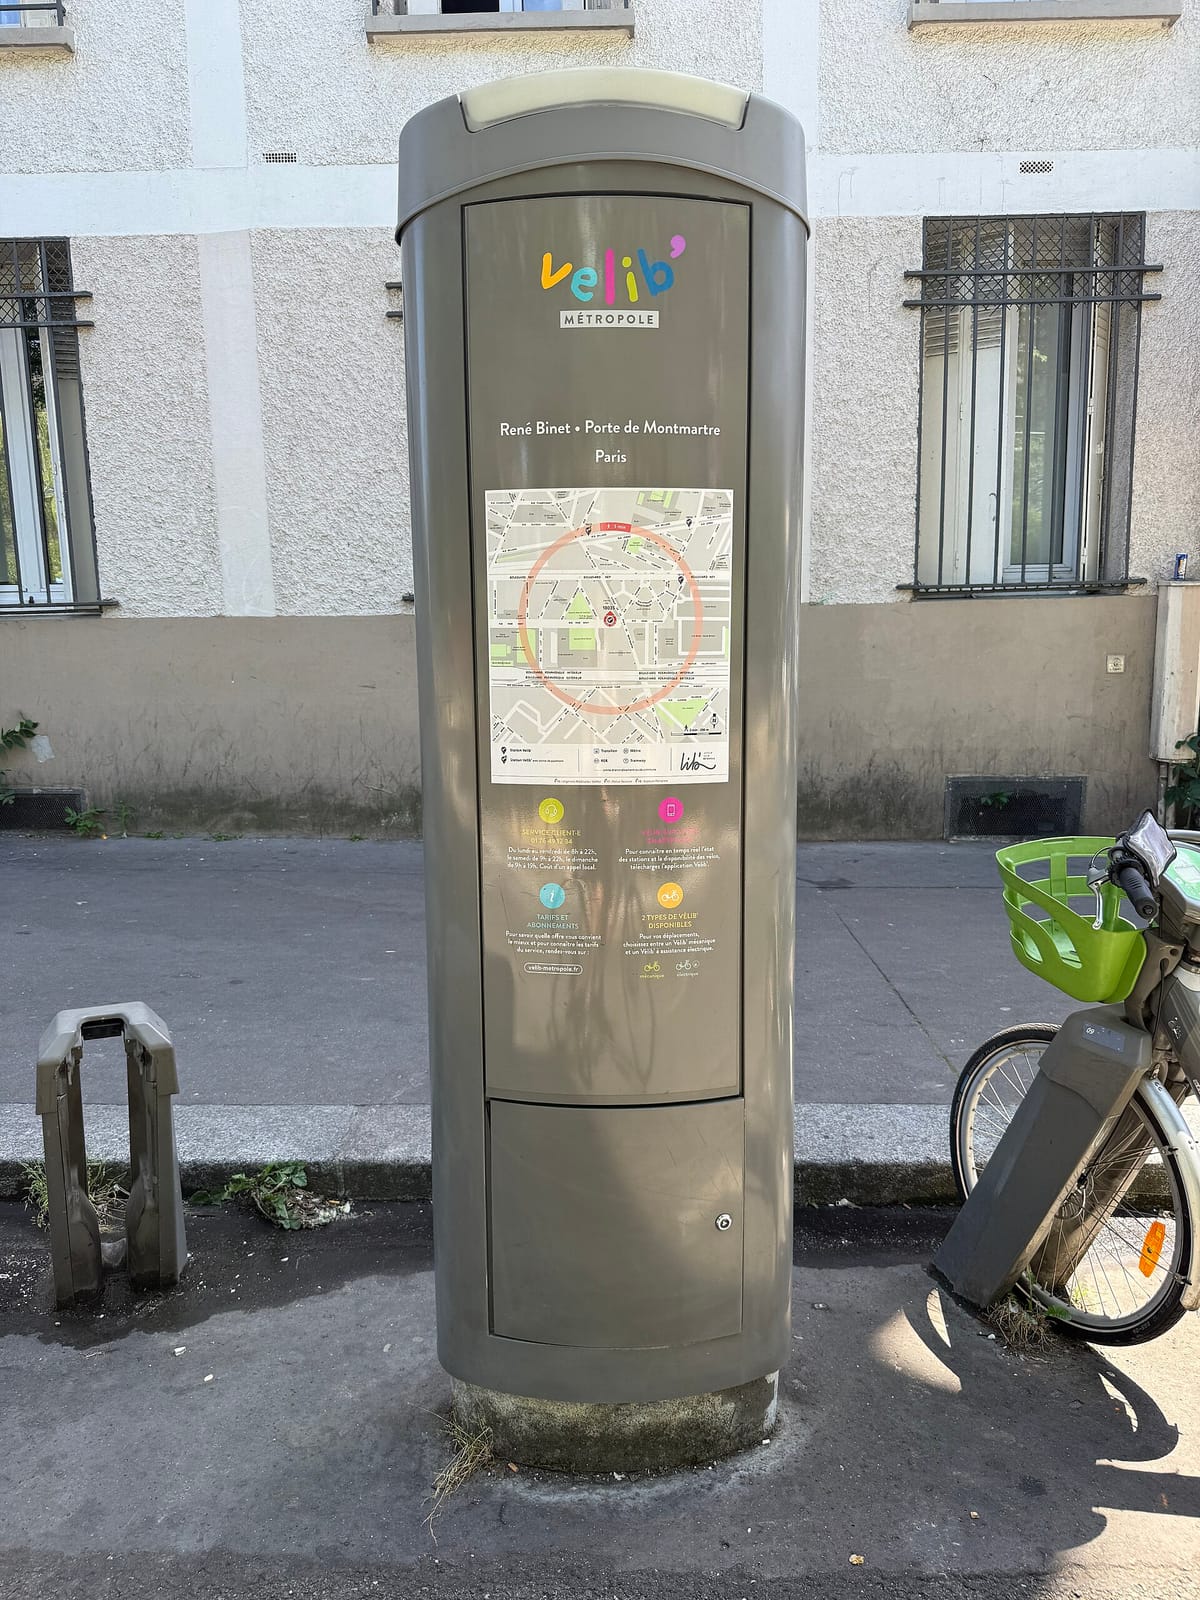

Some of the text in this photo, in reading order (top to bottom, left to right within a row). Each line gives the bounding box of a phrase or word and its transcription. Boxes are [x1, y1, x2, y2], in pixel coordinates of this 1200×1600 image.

[565, 312, 655, 325] MÉTROPOLE
[500, 420, 721, 437] René Binet Porte de Montmartre
[595, 449, 627, 463] Paris
[567, 864, 581, 872] appel
[536, 913, 560, 921] TARIFS
[527, 922, 579, 930] ABONNEMENTS
[648, 921, 693, 929] DISPONIBLES
[534, 932, 551, 940] quelle
